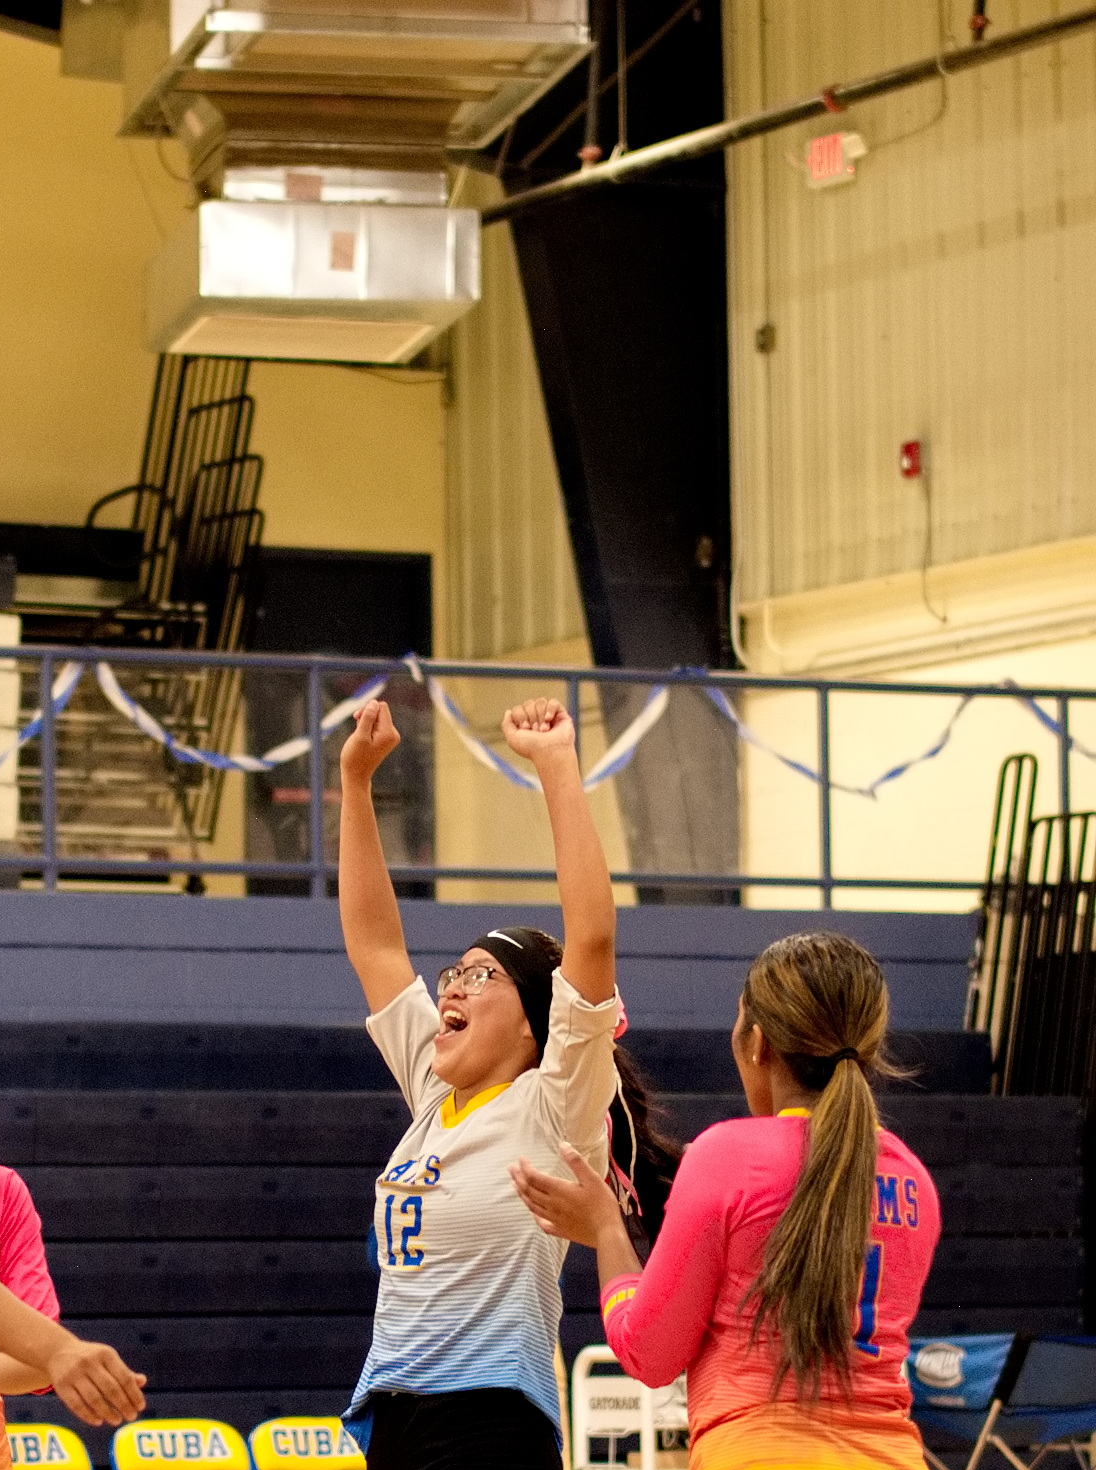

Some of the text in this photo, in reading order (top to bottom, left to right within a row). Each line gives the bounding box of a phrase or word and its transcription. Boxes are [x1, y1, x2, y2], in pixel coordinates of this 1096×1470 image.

[383, 1193, 425, 1268] 12
[589, 1396, 640, 1410] GATORADE
[135, 1430, 232, 1461] CUBA
